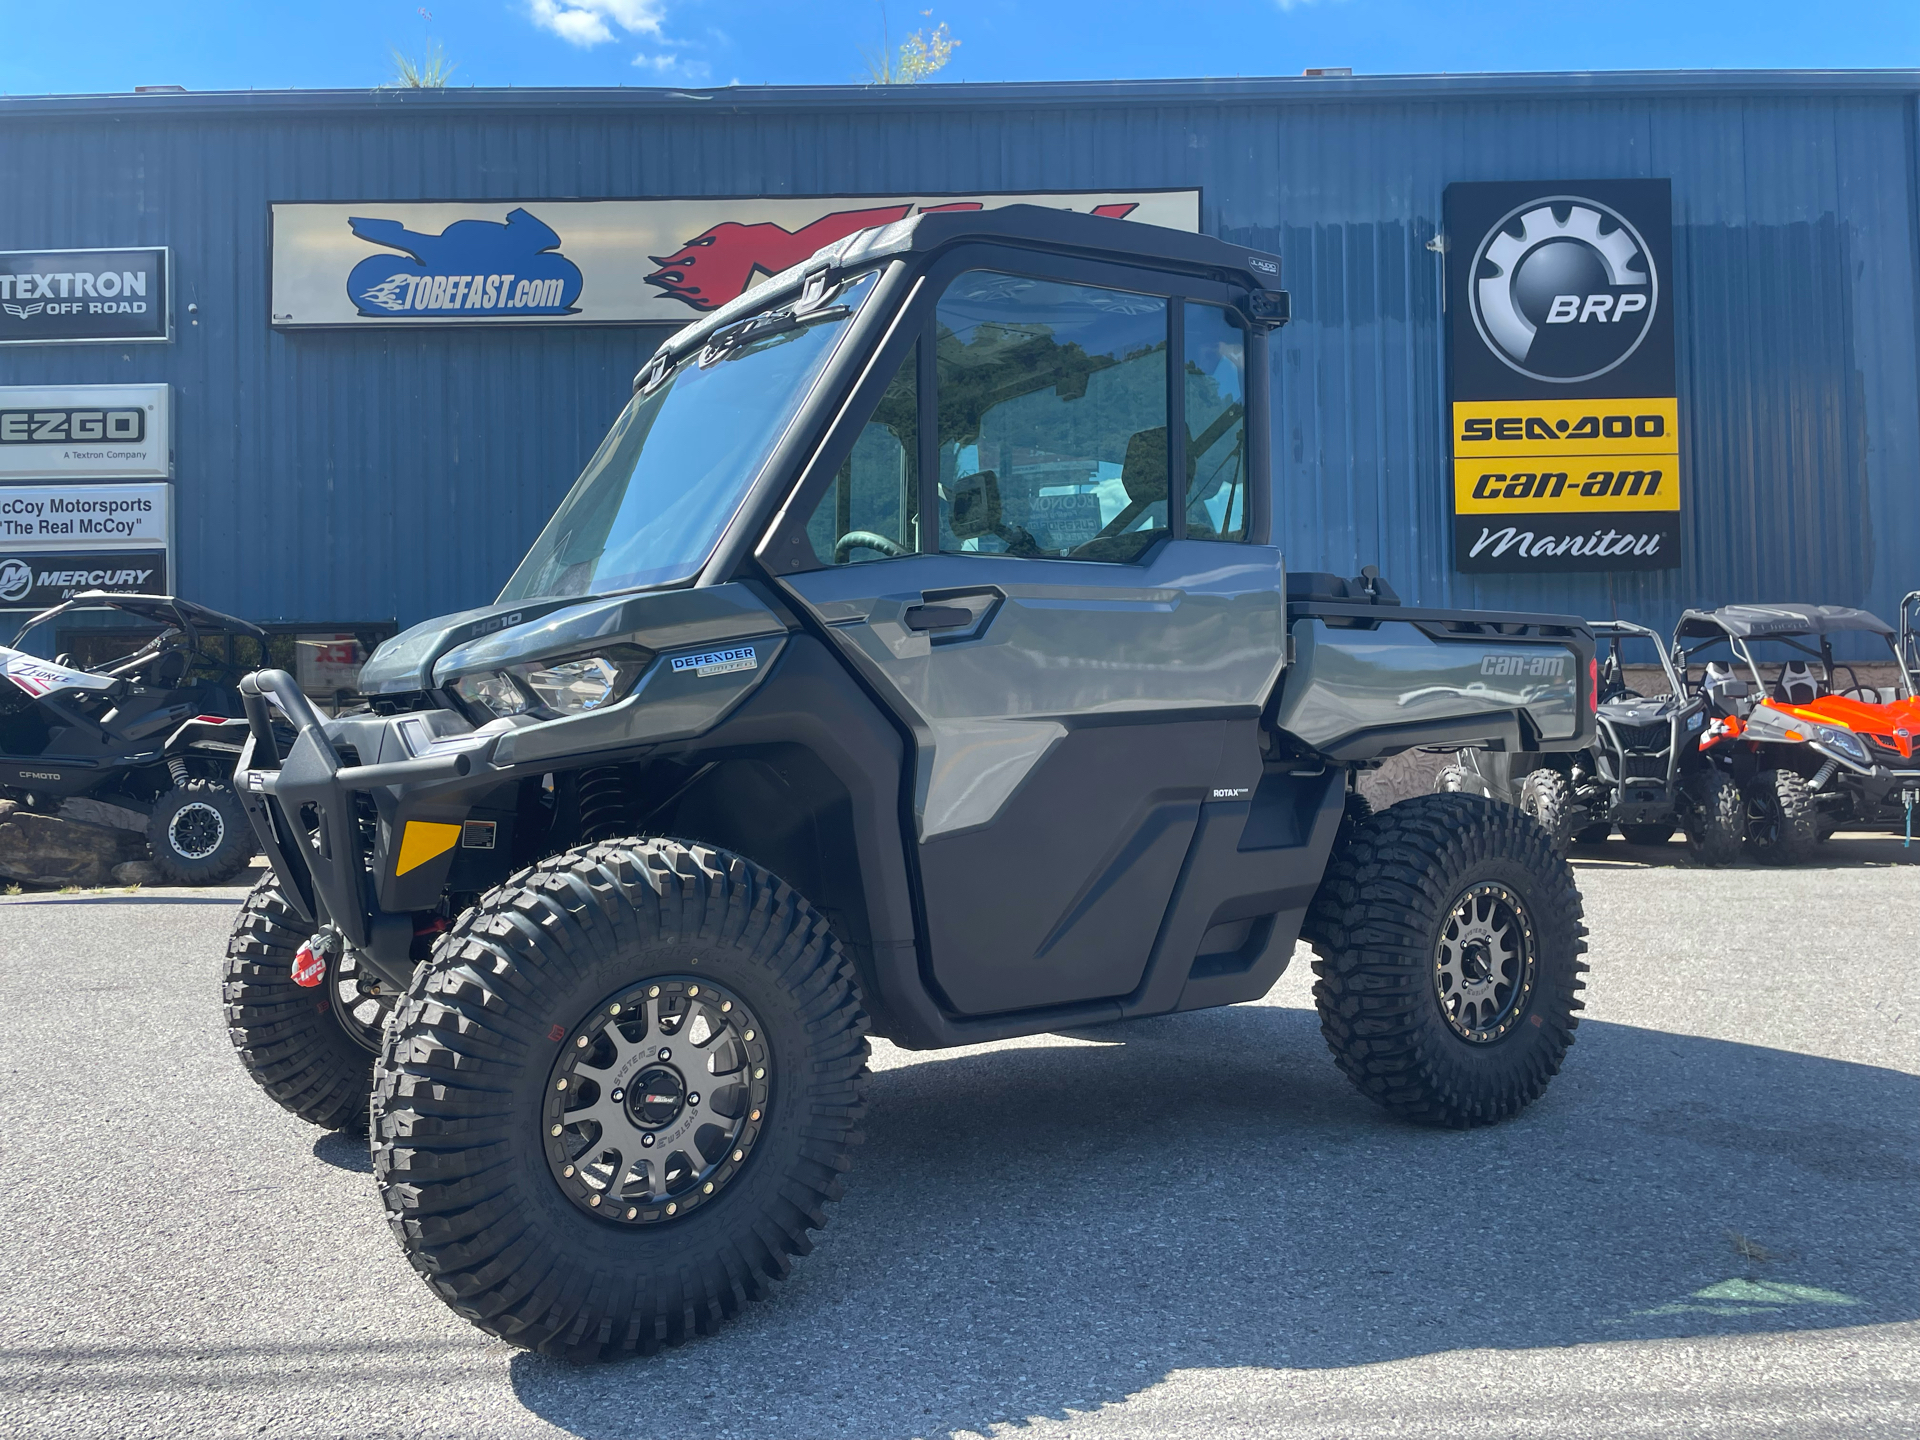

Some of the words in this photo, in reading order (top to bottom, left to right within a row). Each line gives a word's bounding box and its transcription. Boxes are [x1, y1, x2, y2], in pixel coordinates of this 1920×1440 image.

[0, 271, 147, 300] TEXTRON
[403, 274, 565, 310] TOBEFAST.com
[46, 303, 83, 315] OFF
[89, 301, 147, 315] ROAD
[1546, 293, 1647, 324] BRP
[63, 452, 70, 460] A
[72, 451, 104, 460] Textron
[106, 450, 147, 461] Company
[1472, 470, 1663, 500] can-am
[0, 499, 44, 517] cCoy
[50, 498, 152, 516] Motorsports
[38, 519, 74, 534] Real
[79, 518, 142, 536] McCoy"
[1468, 527, 1661, 559] Manitou
[37, 569, 154, 587] MERCURY
[471, 612, 523, 637] HD10
[674, 648, 754, 669] DEFENDER
[1481, 655, 1565, 676] can-am
[19, 771, 61, 781] CFMOTO
[1213, 789, 1239, 798] ROTAX
